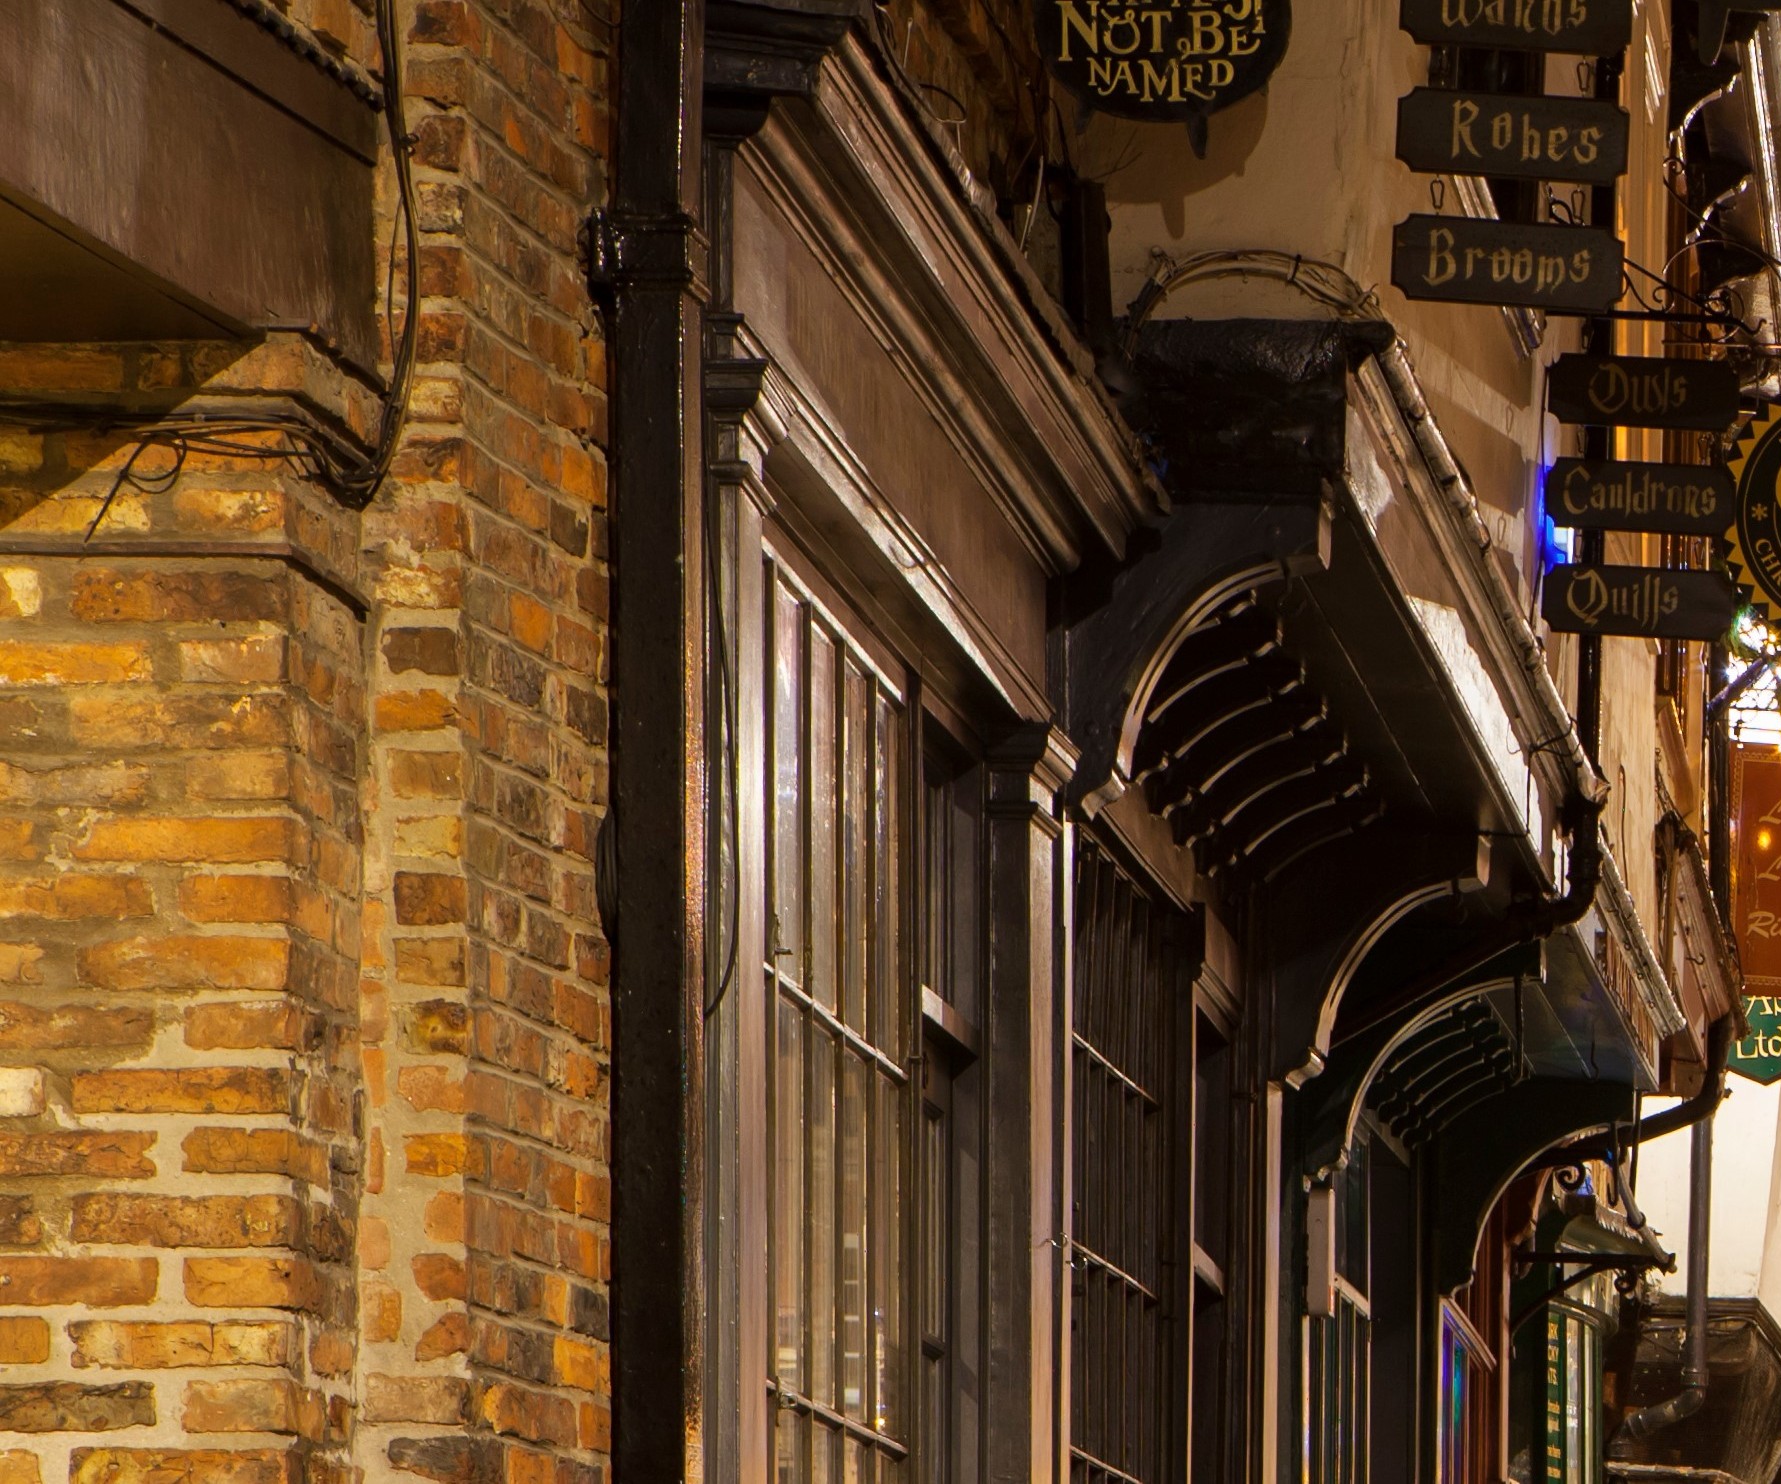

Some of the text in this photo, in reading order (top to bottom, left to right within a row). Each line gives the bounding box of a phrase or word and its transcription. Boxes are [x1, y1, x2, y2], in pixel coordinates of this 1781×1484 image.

[1057, 0, 1261, 62] NOT BE
[1086, 57, 1235, 102] NAMED
[1451, 99, 1604, 165] Robes
[1422, 227, 1592, 295] Brooms
[1588, 363, 1689, 416] Owls
[1563, 464, 1717, 520] Cauldrons
[1565, 567, 1680, 631] Quills
